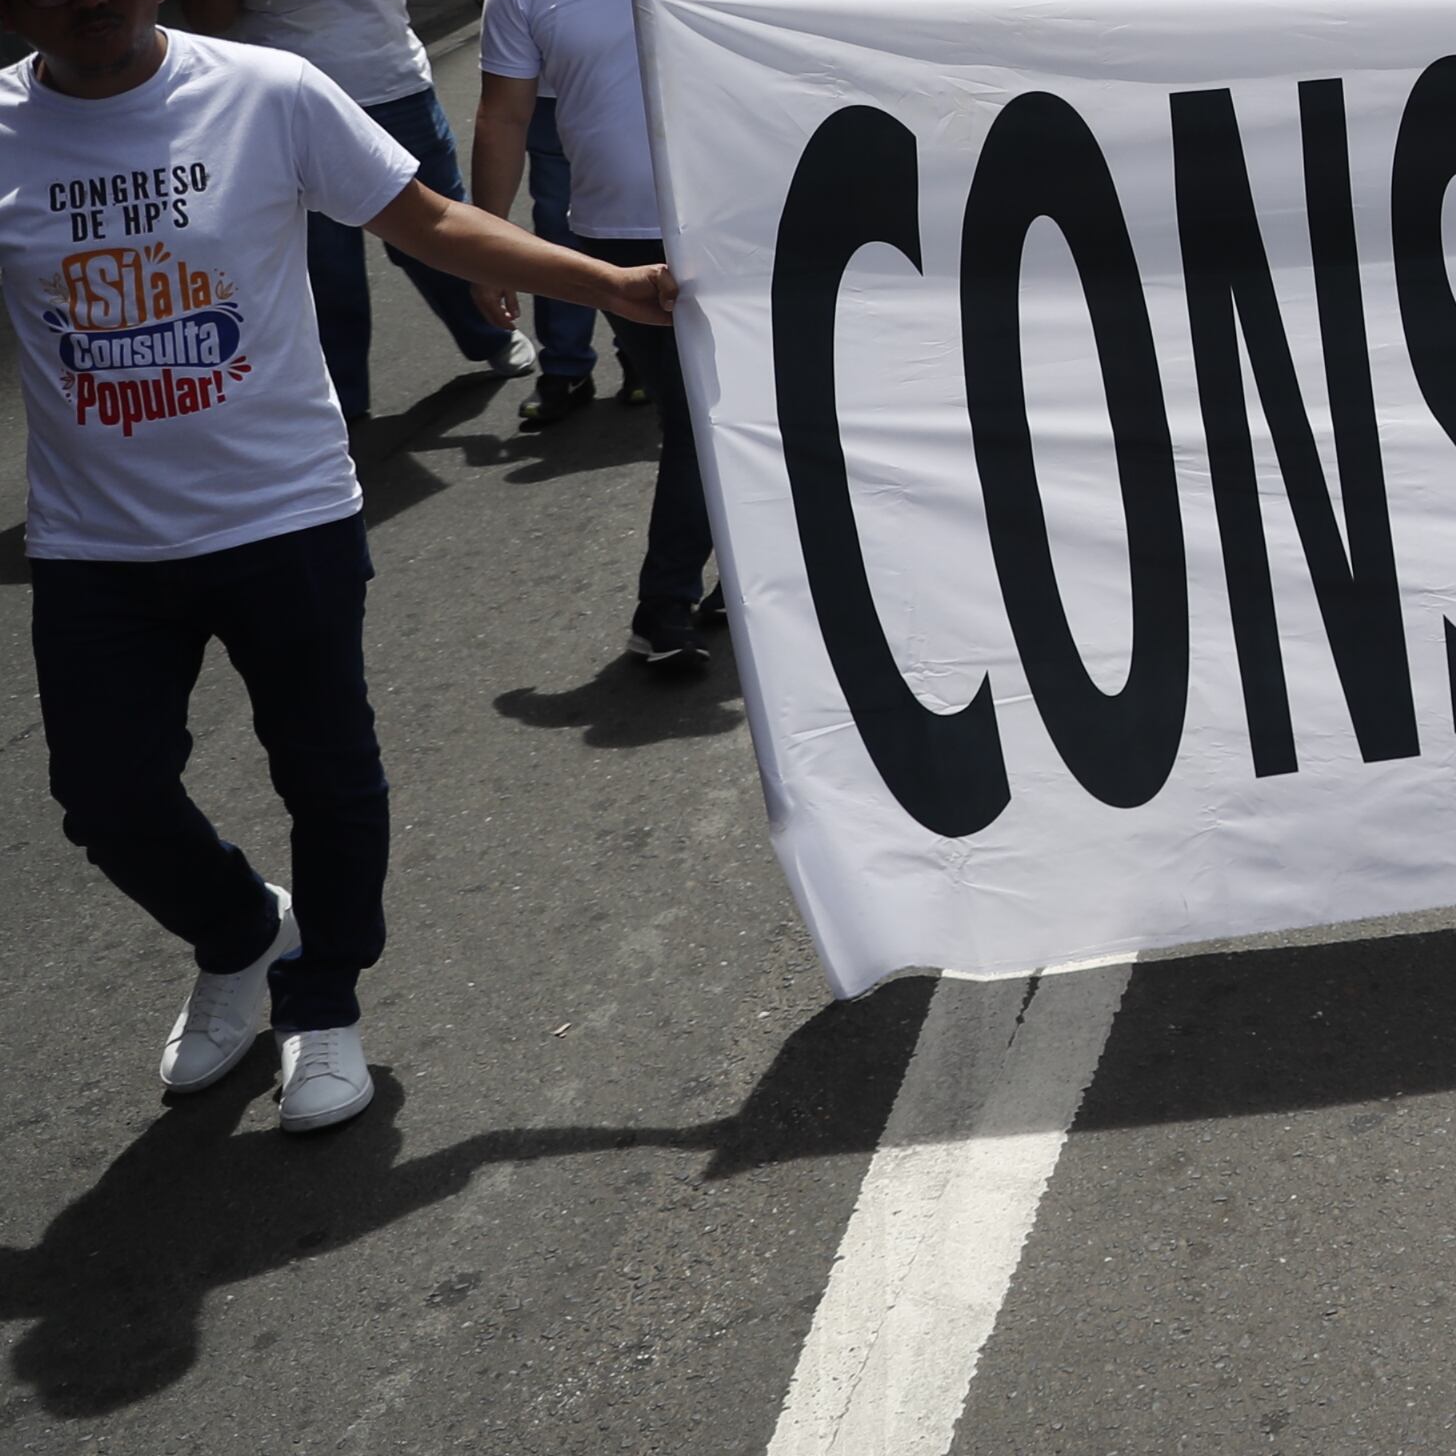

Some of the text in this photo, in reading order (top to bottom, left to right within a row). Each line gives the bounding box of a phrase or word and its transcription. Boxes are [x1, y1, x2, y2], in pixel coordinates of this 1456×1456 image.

[49, 161, 208, 213] CONGRESO
[70, 198, 190, 243] DE HP'S
[150, 271, 173, 321] a
[177, 260, 212, 312] la
[69, 318, 221, 371] Consulta
[76, 367, 227, 438] Popular!
